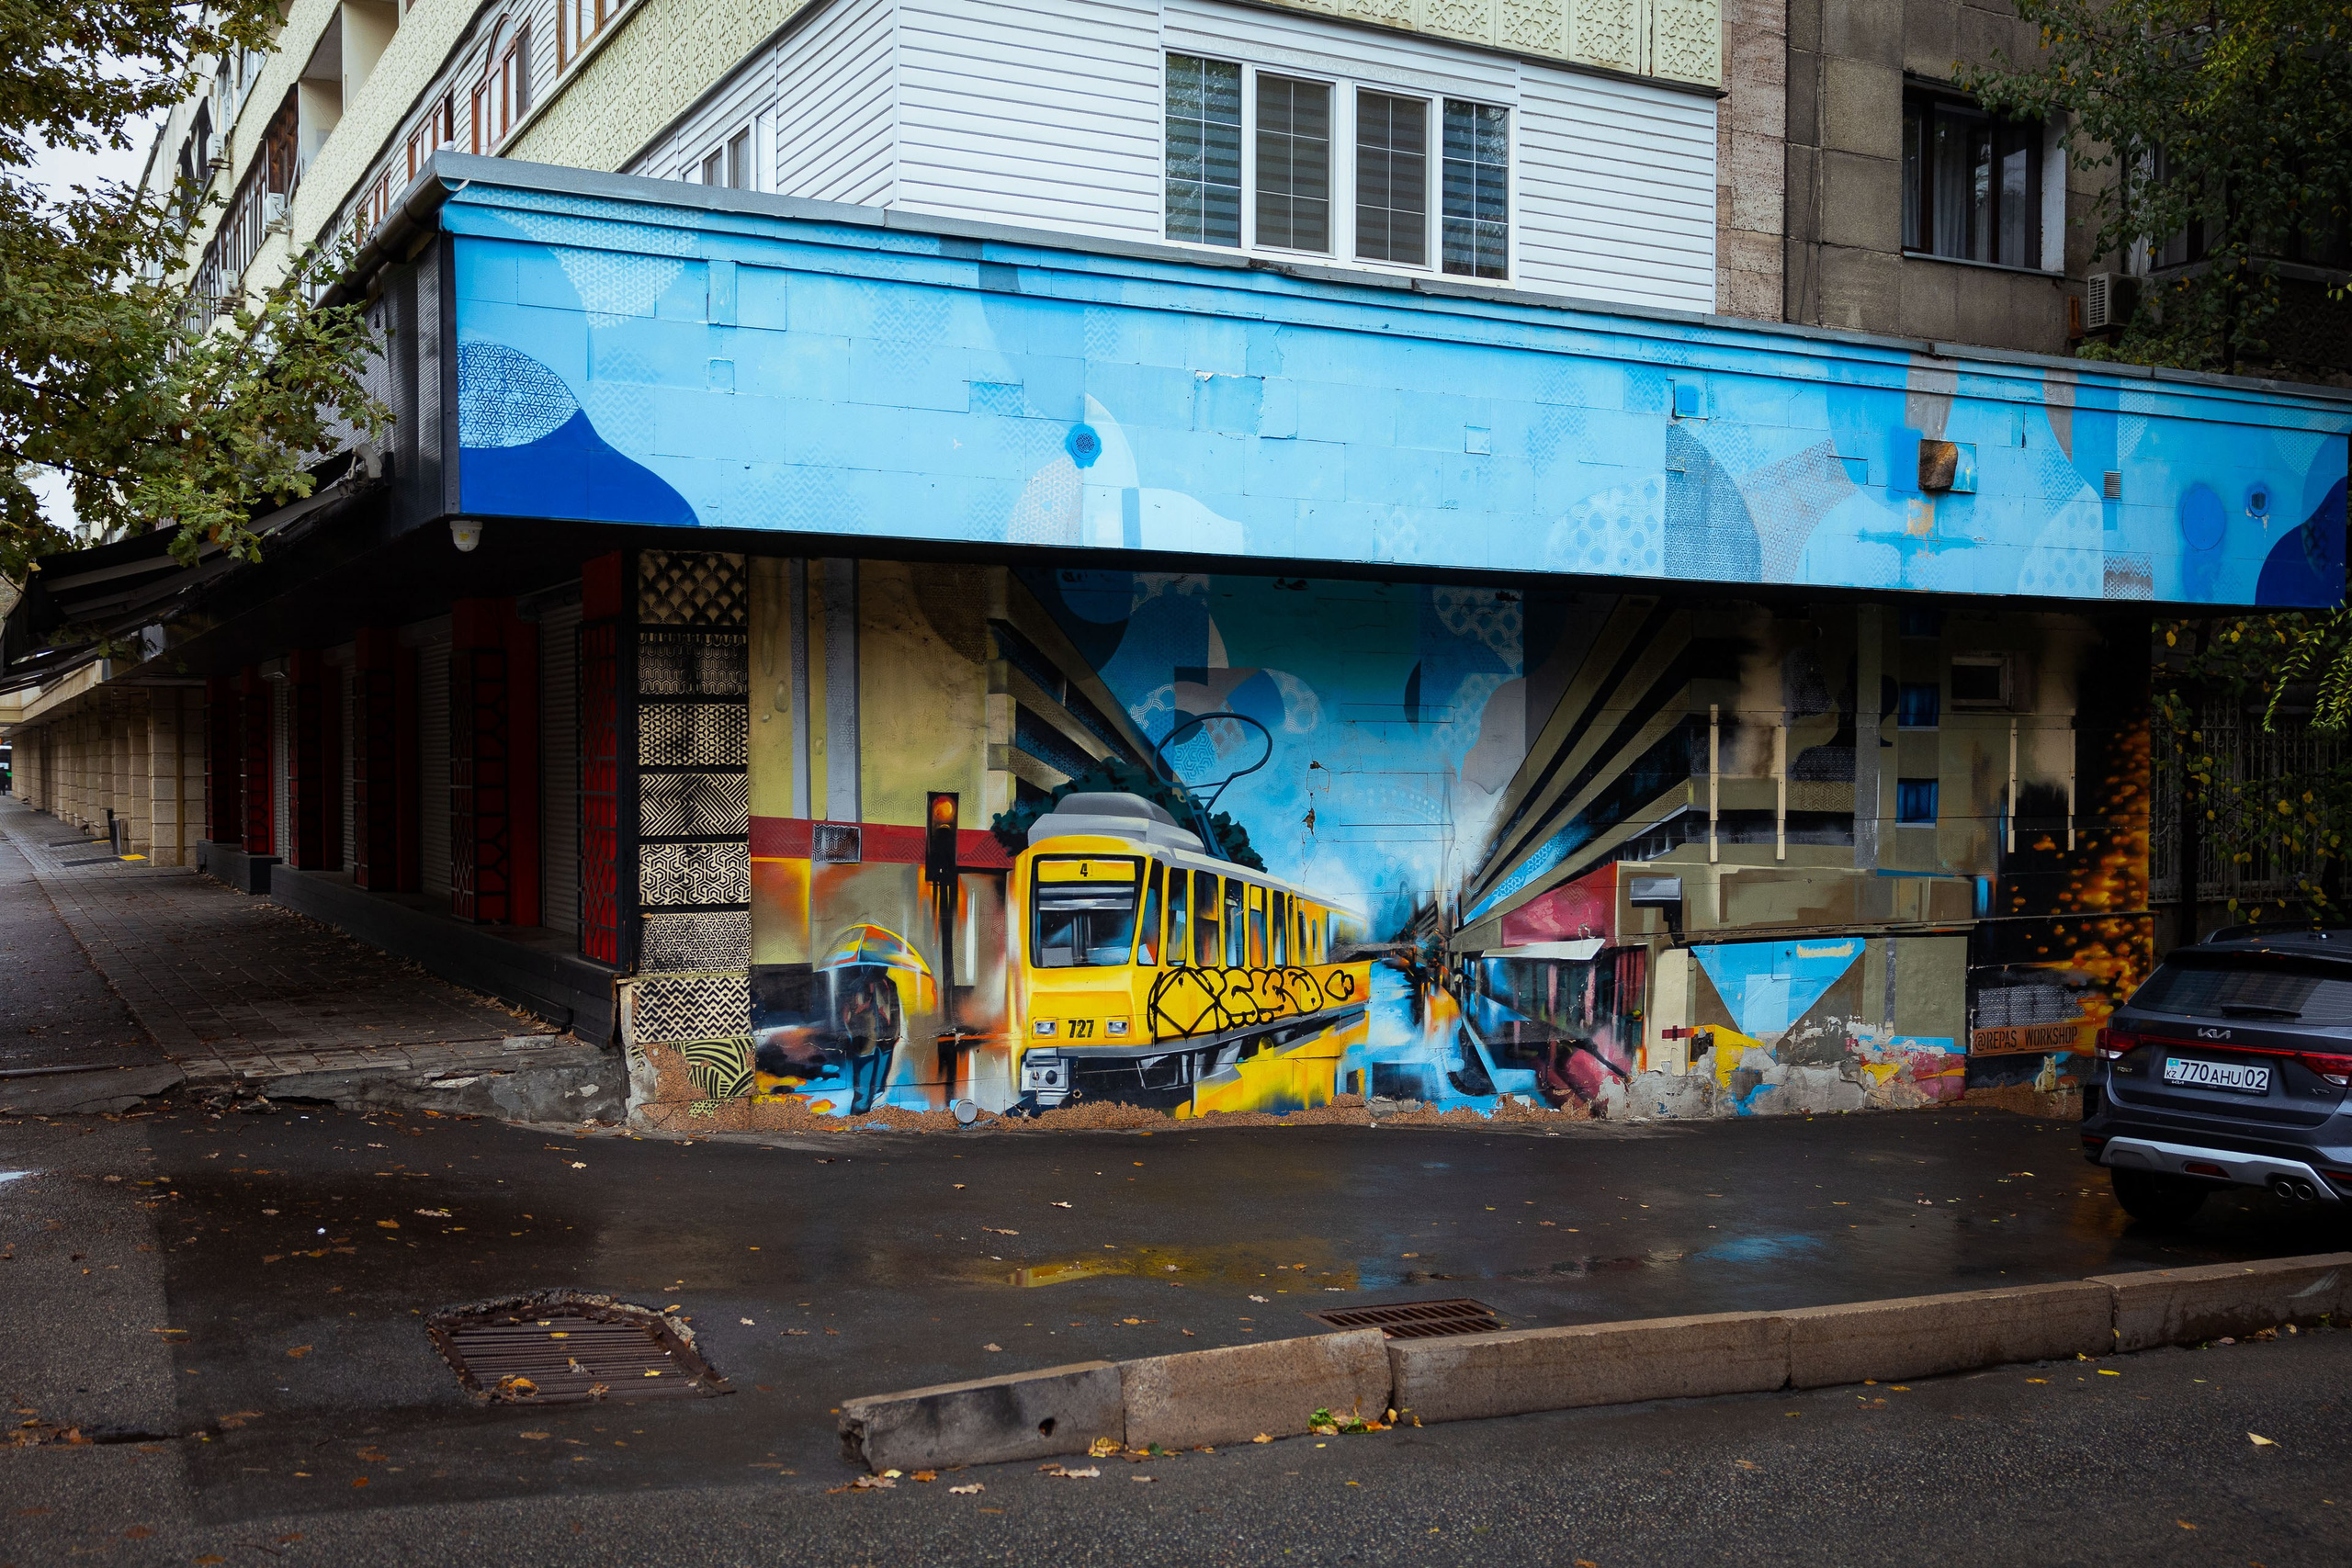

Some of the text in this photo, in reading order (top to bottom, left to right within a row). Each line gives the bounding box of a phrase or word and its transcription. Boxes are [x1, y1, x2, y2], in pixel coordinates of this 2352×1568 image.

[1068, 1019, 1095, 1039] 727
[2198, 1027, 2232, 1040] KIA
[2165, 1070, 2177, 1078] KZ
